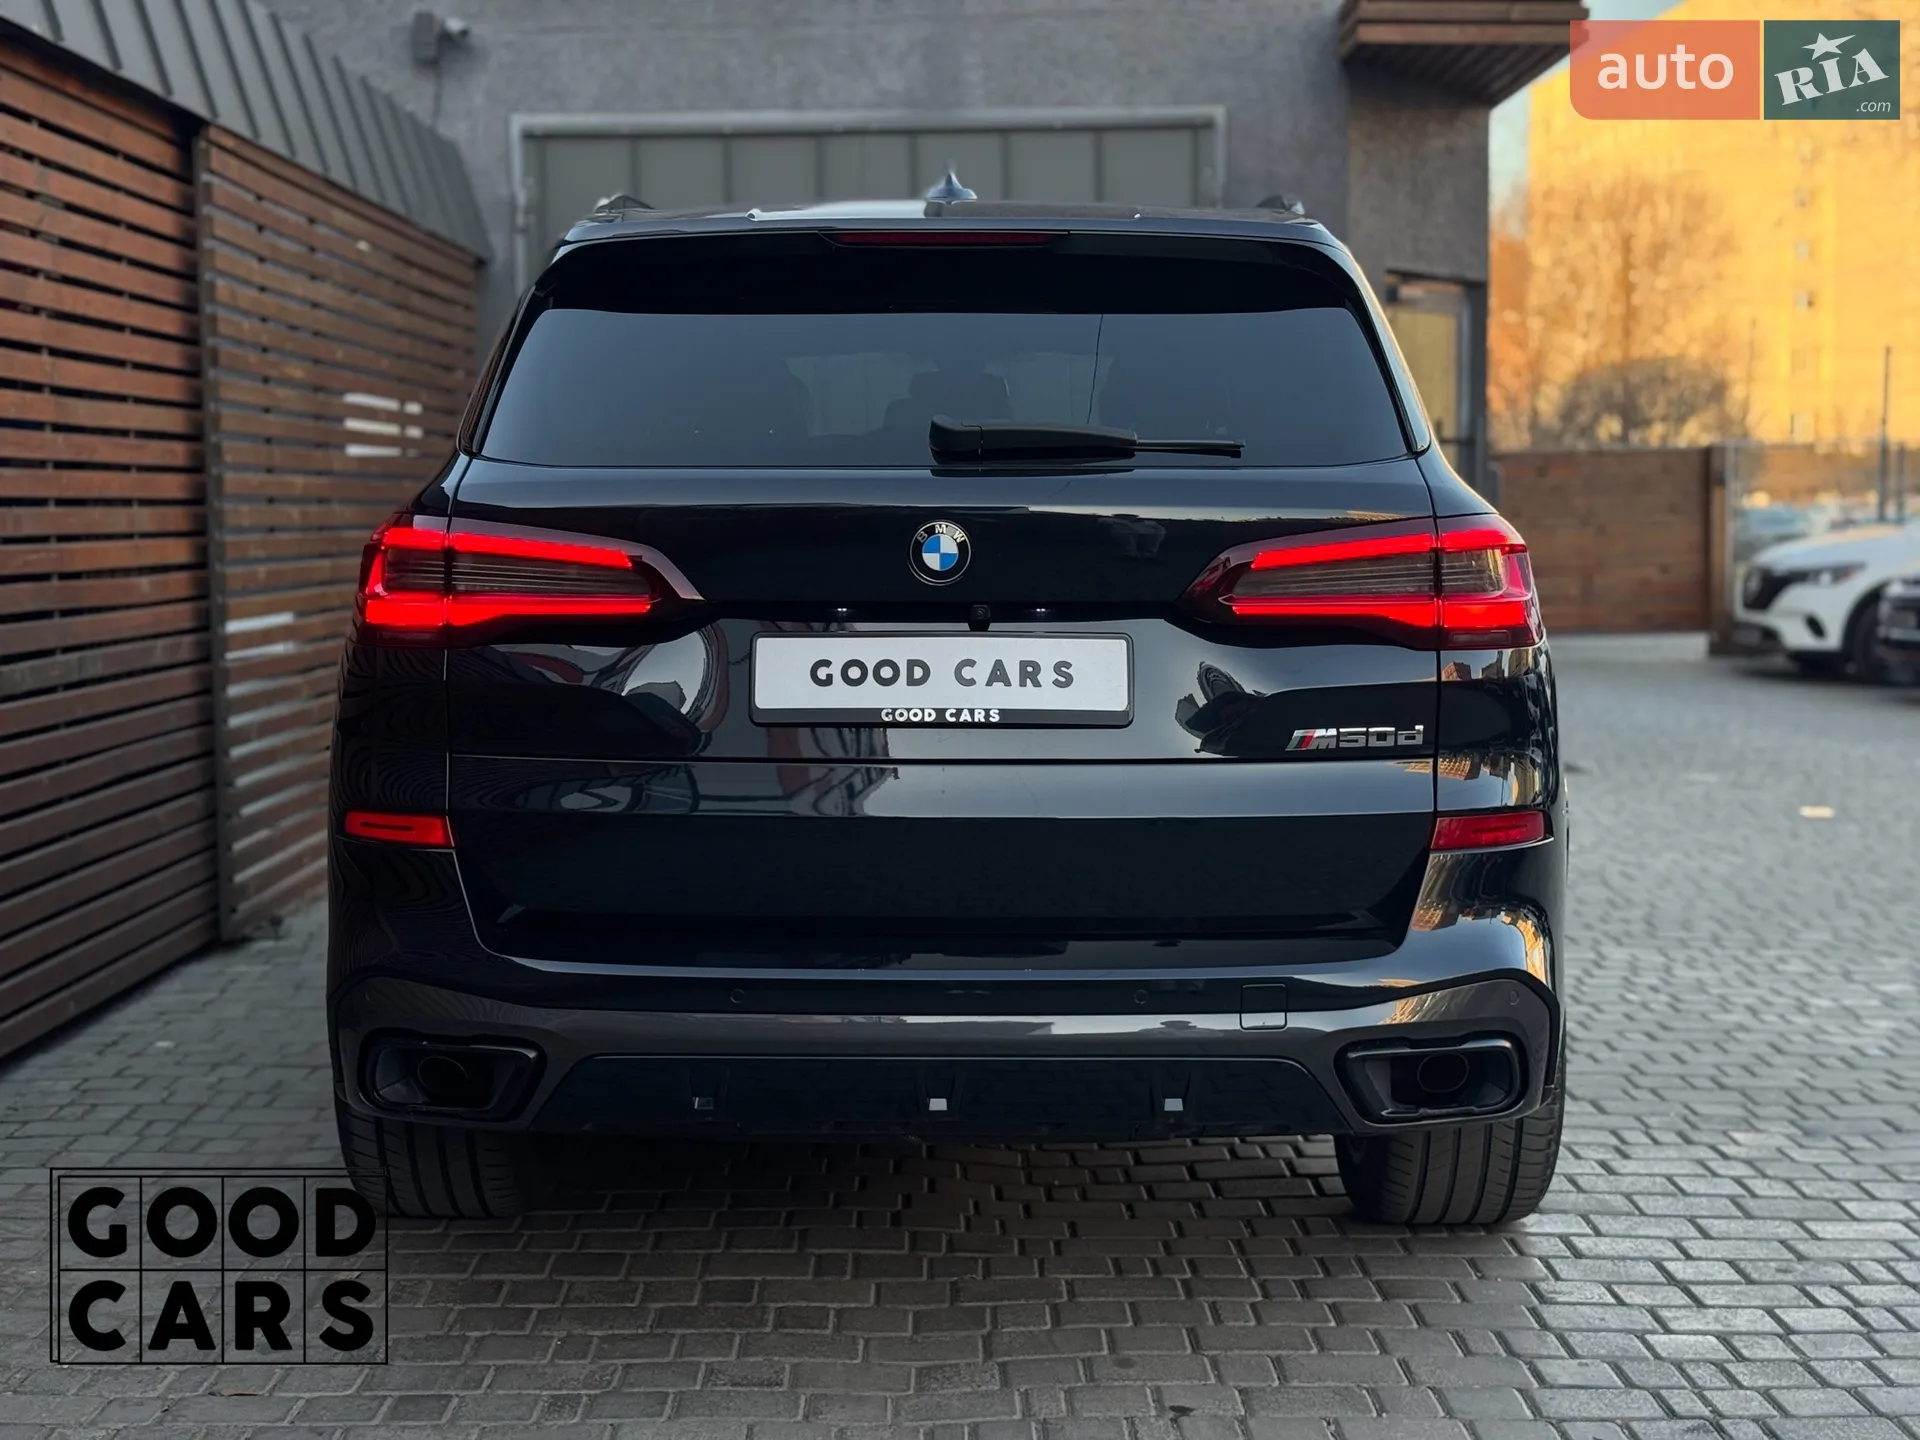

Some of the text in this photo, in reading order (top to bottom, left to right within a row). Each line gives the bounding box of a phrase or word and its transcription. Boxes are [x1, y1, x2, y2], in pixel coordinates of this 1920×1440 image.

[916, 523, 967, 544] BMW
[809, 658, 1074, 689] GOOD CARS
[880, 708, 1001, 723] GOOD CARS
[1285, 724, 1424, 751] M50d
